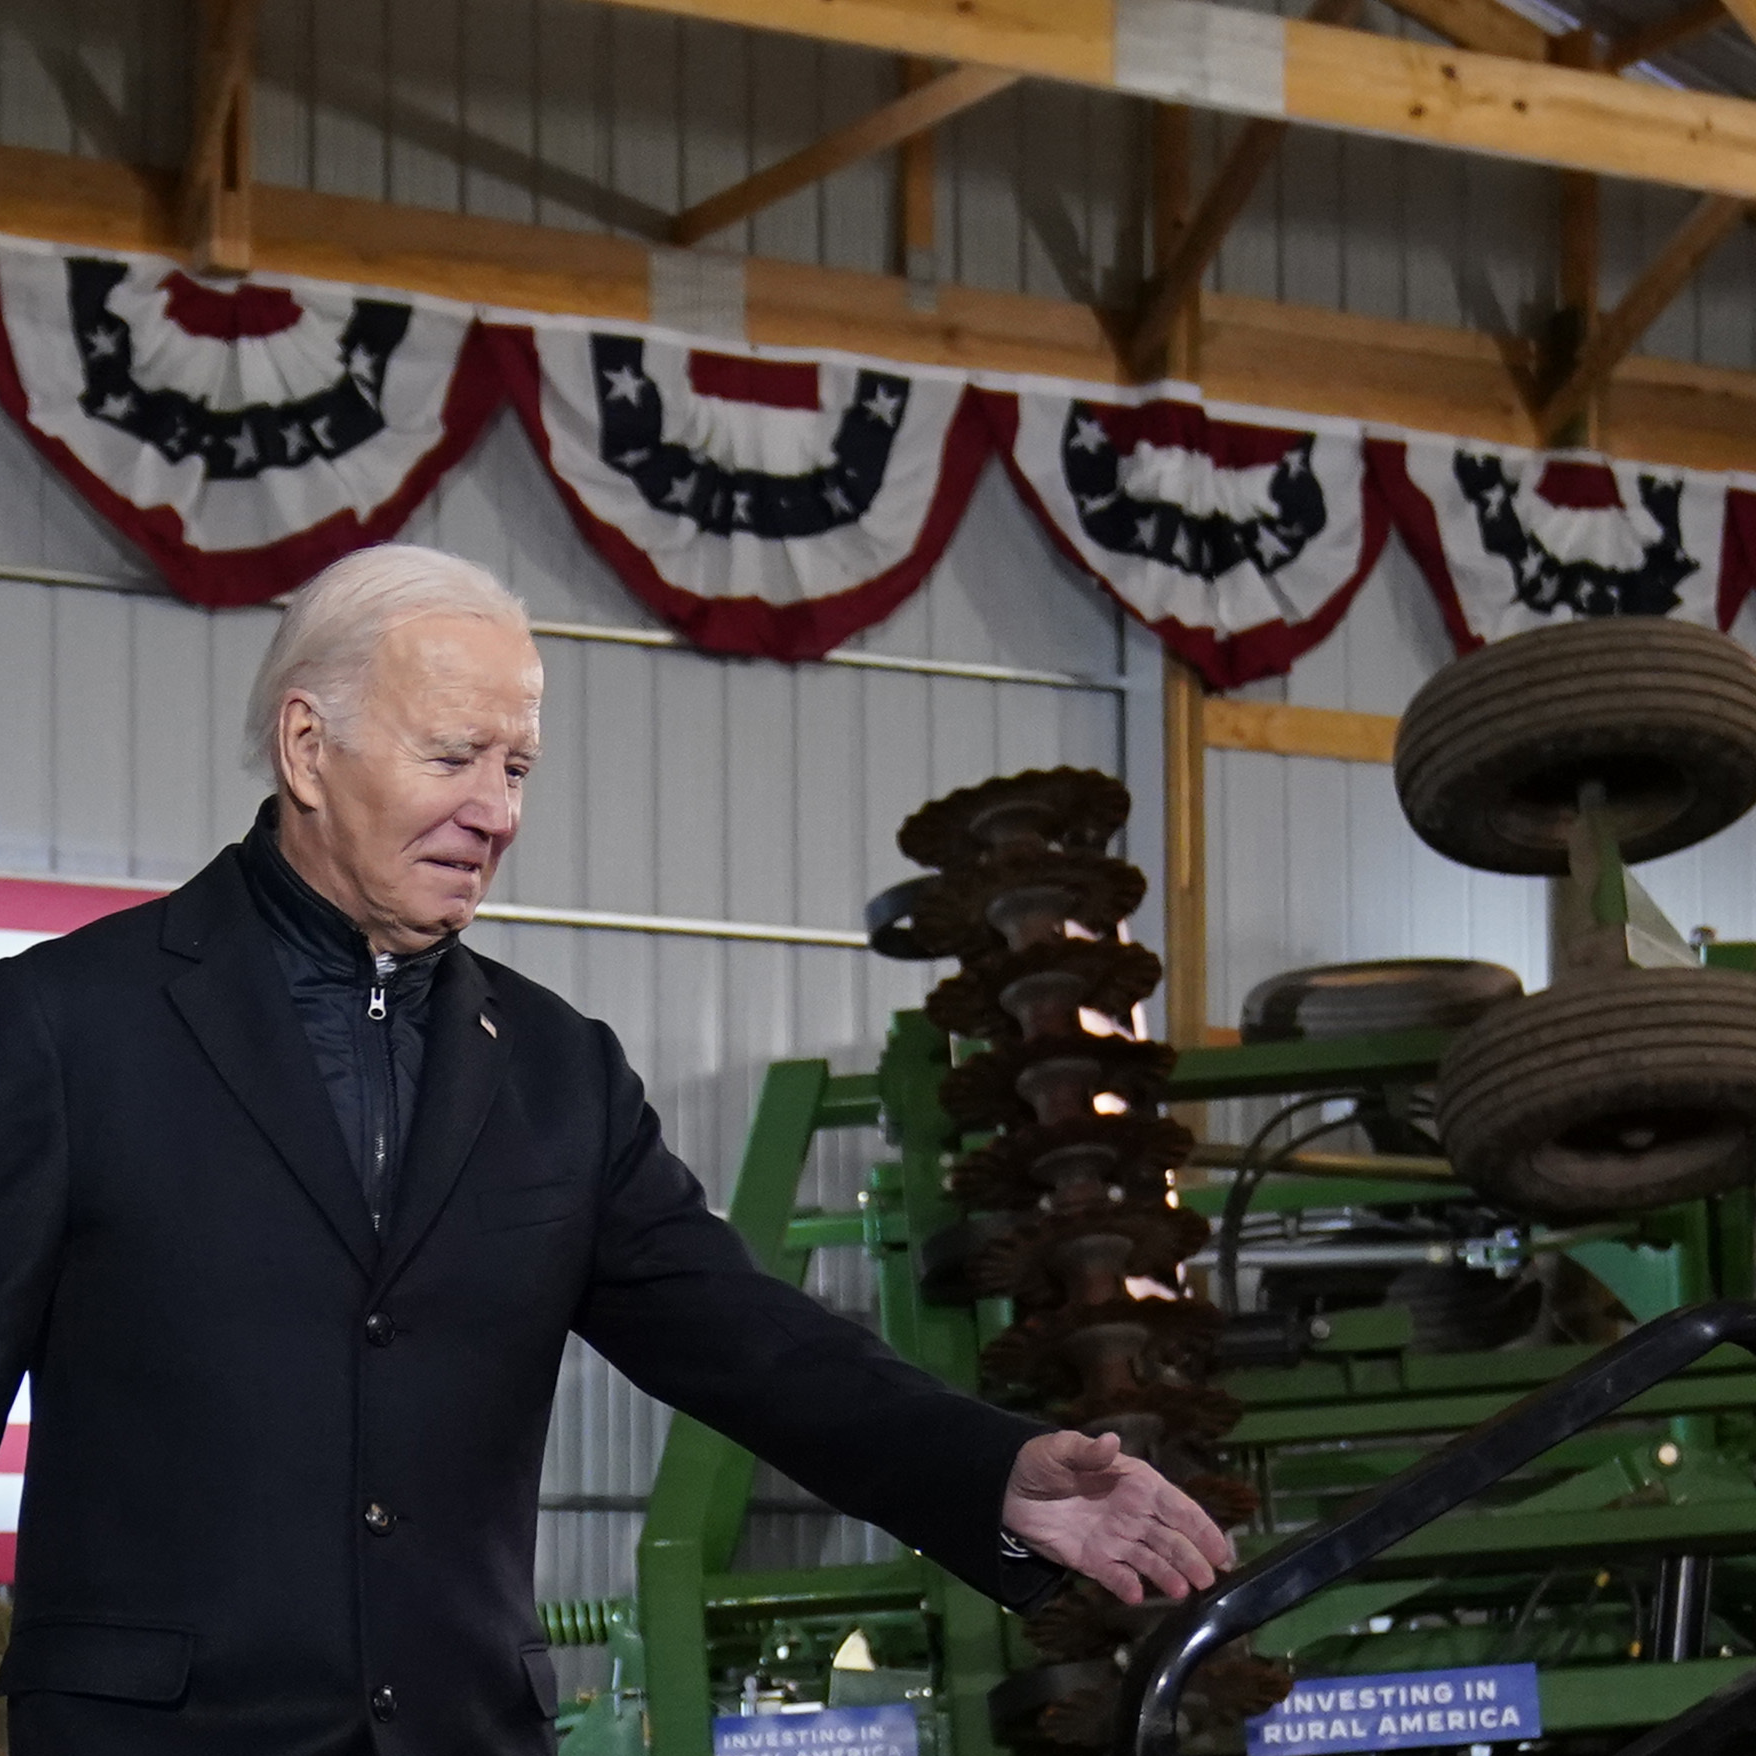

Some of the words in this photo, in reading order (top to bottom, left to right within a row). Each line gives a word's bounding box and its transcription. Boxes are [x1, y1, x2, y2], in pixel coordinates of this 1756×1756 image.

[1283, 1681, 1453, 1715] INVESTING
[1465, 1679, 1497, 1701] IN
[723, 1727, 855, 1749] INVESTING
[861, 1725, 885, 1741] IN
[1263, 1718, 1367, 1744] RURAL
[1378, 1705, 1520, 1736] AMERICA
